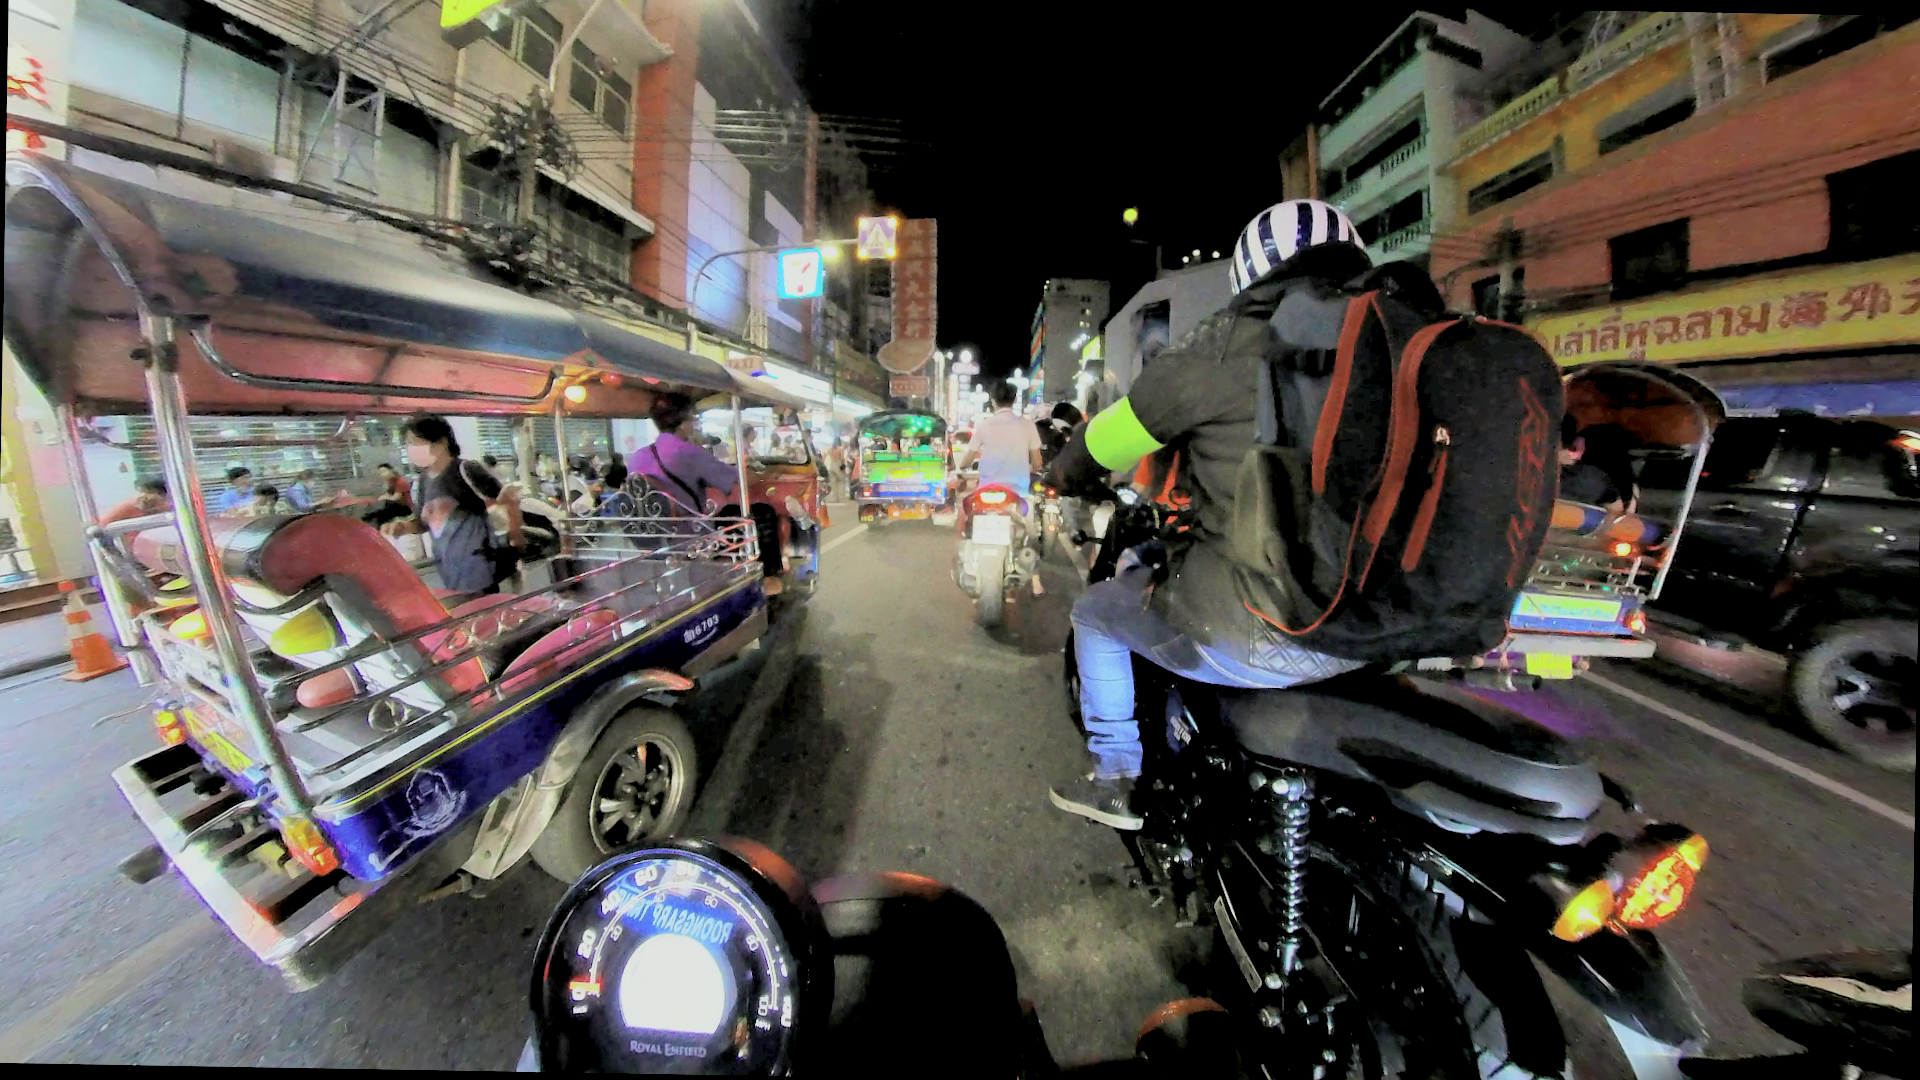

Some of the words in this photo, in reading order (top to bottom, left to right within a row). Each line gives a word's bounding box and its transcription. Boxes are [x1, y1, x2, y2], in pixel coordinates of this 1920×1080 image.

[634, 864, 657, 887] 60
[577, 928, 596, 959] 20
[630, 1040, 662, 1054] ROYAL
